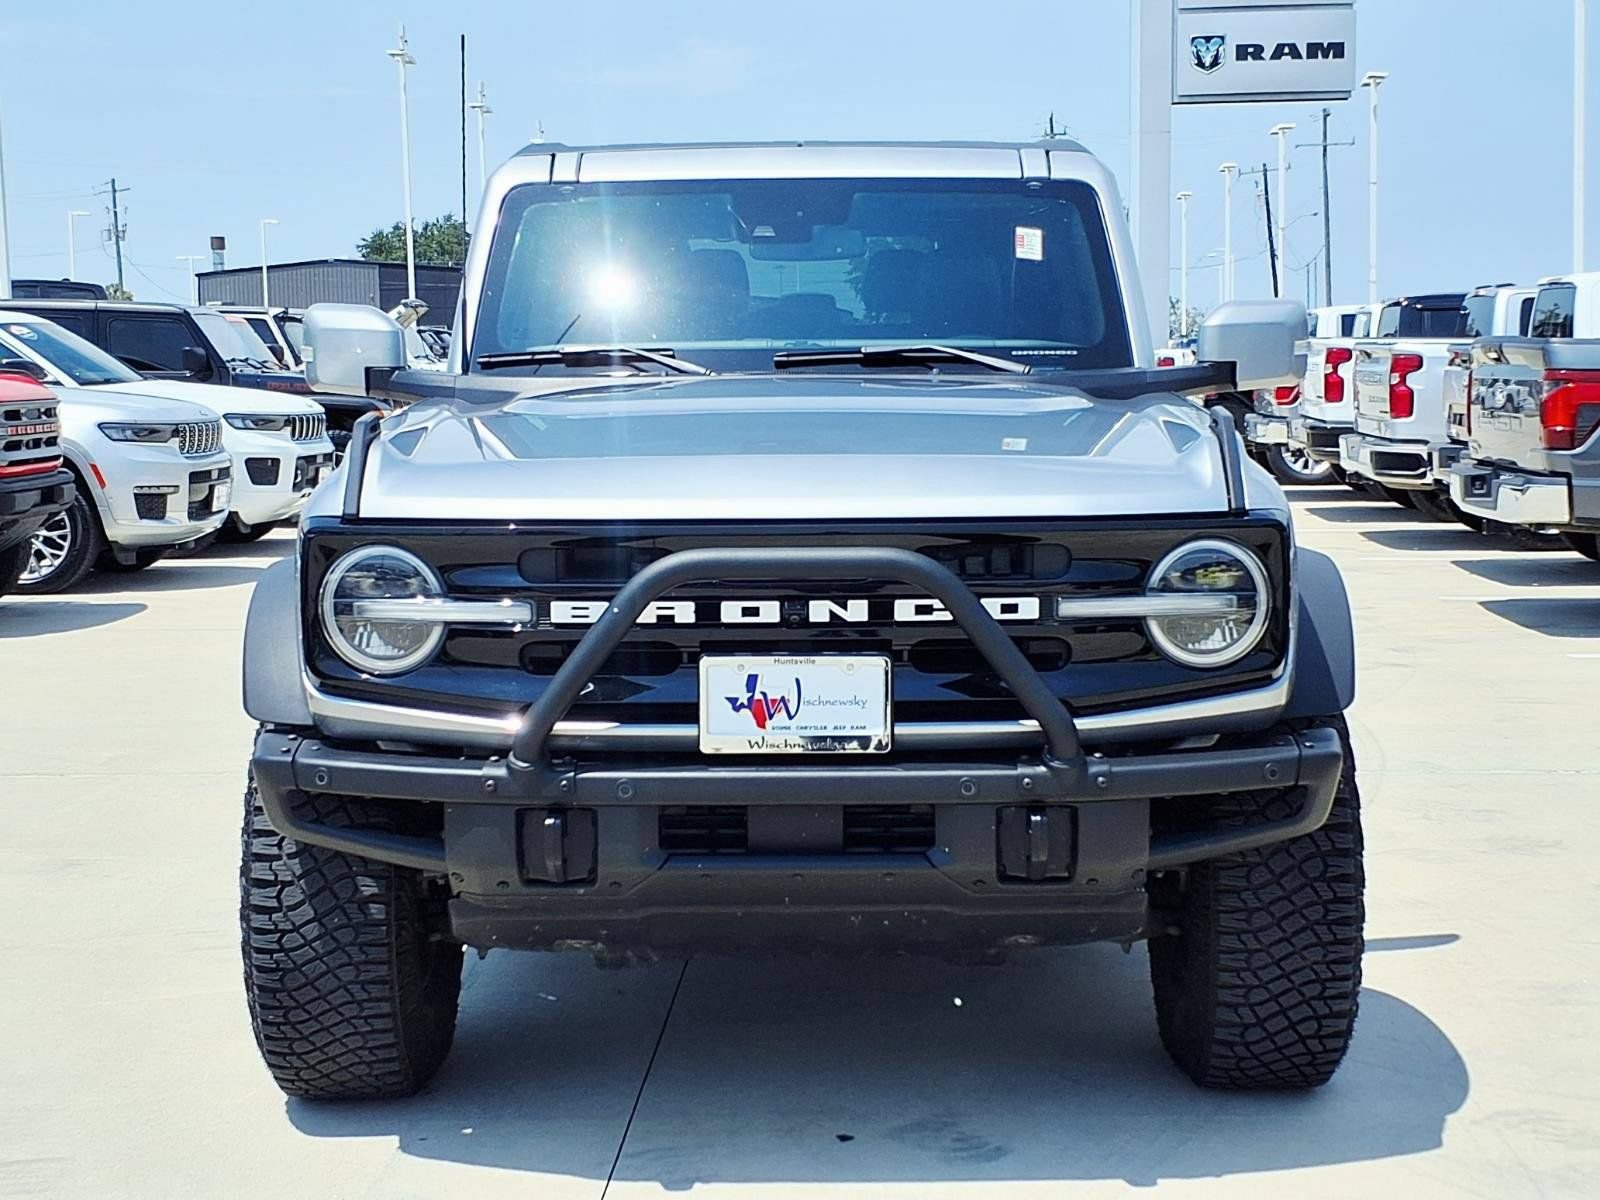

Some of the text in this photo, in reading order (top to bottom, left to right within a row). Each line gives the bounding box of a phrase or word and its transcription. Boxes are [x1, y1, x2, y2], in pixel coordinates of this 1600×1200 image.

[1236, 42, 1345, 61] RAM
[550, 598, 1040, 624] BRONCO
[760, 677, 868, 721] Wischnewsky
